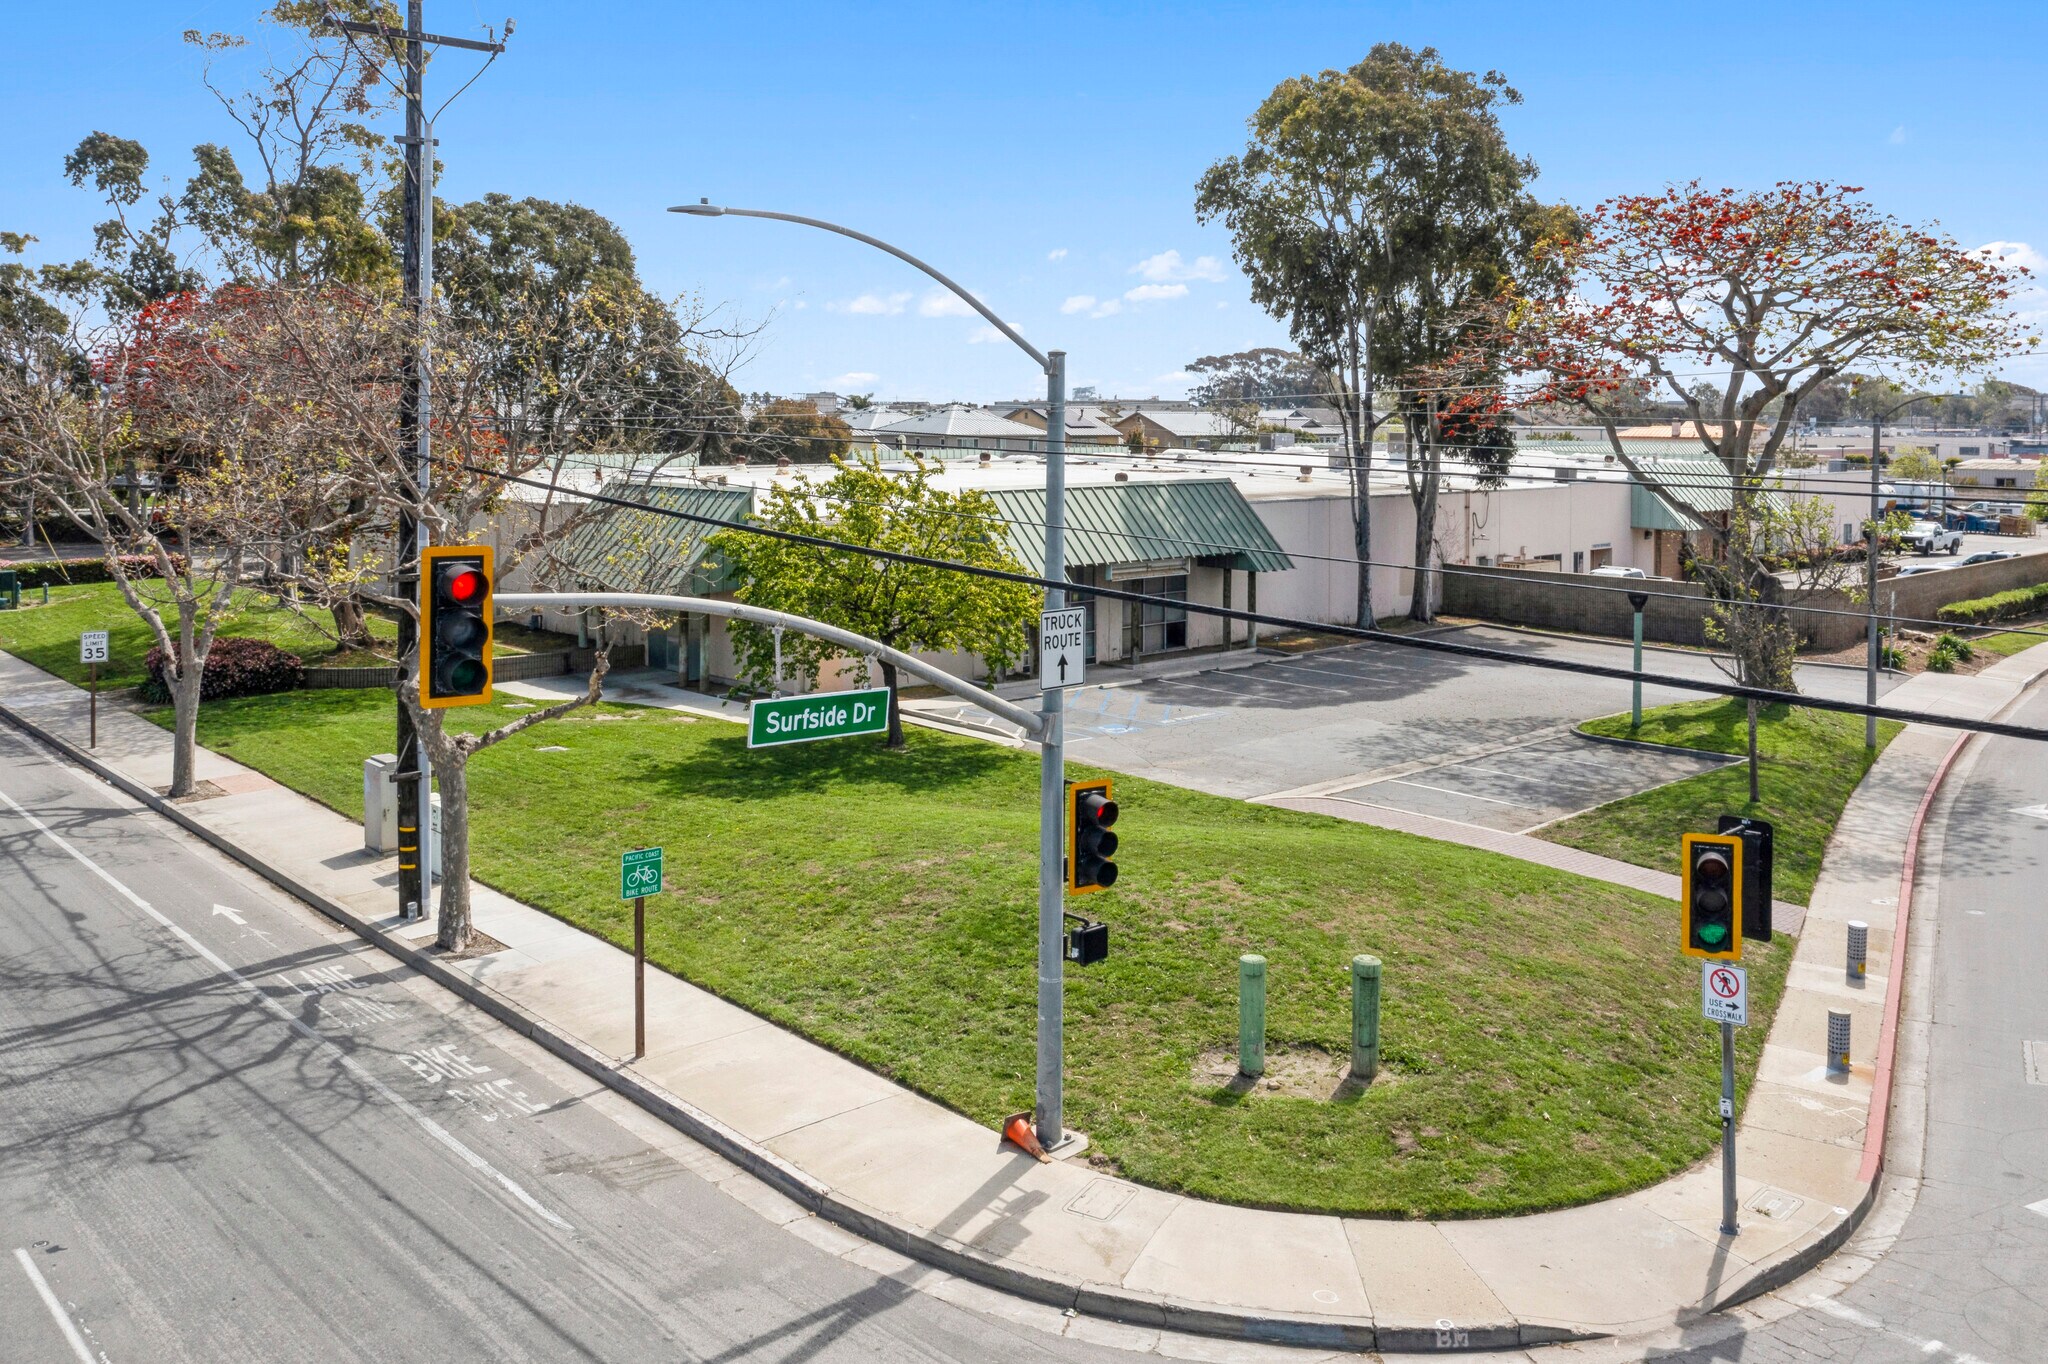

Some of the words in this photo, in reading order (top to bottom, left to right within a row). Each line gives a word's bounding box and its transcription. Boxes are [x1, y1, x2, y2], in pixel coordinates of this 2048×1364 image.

[1044, 613, 1082, 631] TRUCK
[1044, 632, 1081, 650] ROUTE
[84, 648, 105, 659] 35
[766, 705, 847, 734] Surfside
[853, 702, 876, 723] Dr
[645, 850, 660, 858] COAST
[626, 888, 639, 897] BIKE
[641, 884, 658, 894] ROUTE
[276, 965, 371, 997] LANE
[1709, 998, 1723, 1008] USE
[1707, 1008, 1742, 1021] CROSSWALK
[397, 1044, 492, 1083] BIKE
